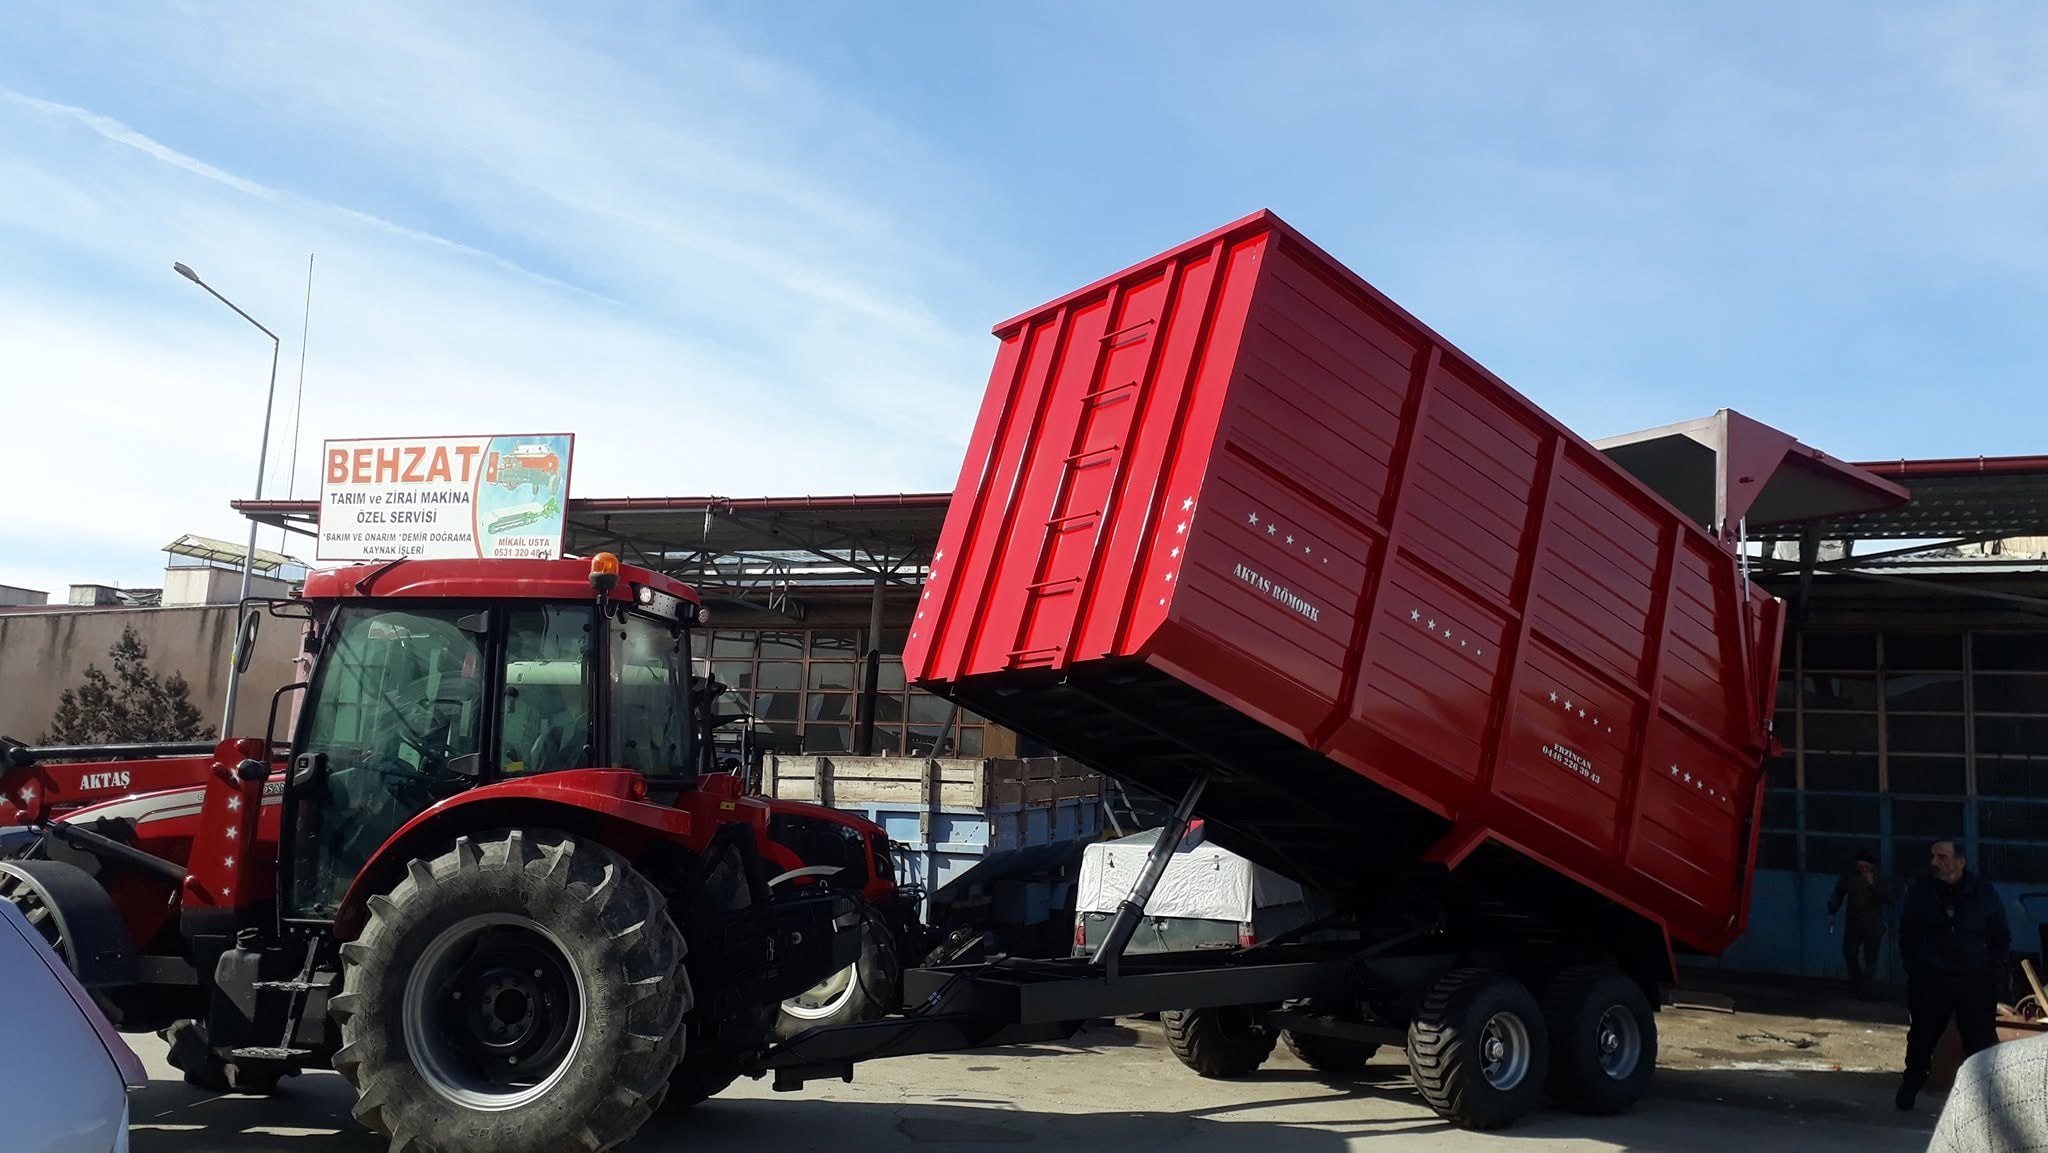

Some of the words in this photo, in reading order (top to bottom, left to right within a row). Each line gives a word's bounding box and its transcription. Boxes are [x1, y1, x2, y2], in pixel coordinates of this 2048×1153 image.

[328, 445, 480, 484] BEHZAT
[331, 492, 366, 505] TARIM
[369, 494, 382, 505] ve
[385, 489, 417, 504] ZİRAİ
[420, 488, 470, 504] MAKİNA
[356, 508, 386, 523] ÖZEL
[390, 507, 437, 523] SERVİSİ
[353, 533, 363, 541] VE
[364, 533, 396, 542] ONARIM
[429, 531, 472, 542] DOĞRAMA
[528, 538, 550, 547] USTA
[363, 545, 396, 554] KAYNAK
[494, 548, 512, 557] 0531
[515, 548, 529, 557] 320
[1233, 563, 1270, 594] AKTAŞ
[1271, 585, 1320, 623] RÖMORK
[80, 771, 131, 790] AKTAŞ
